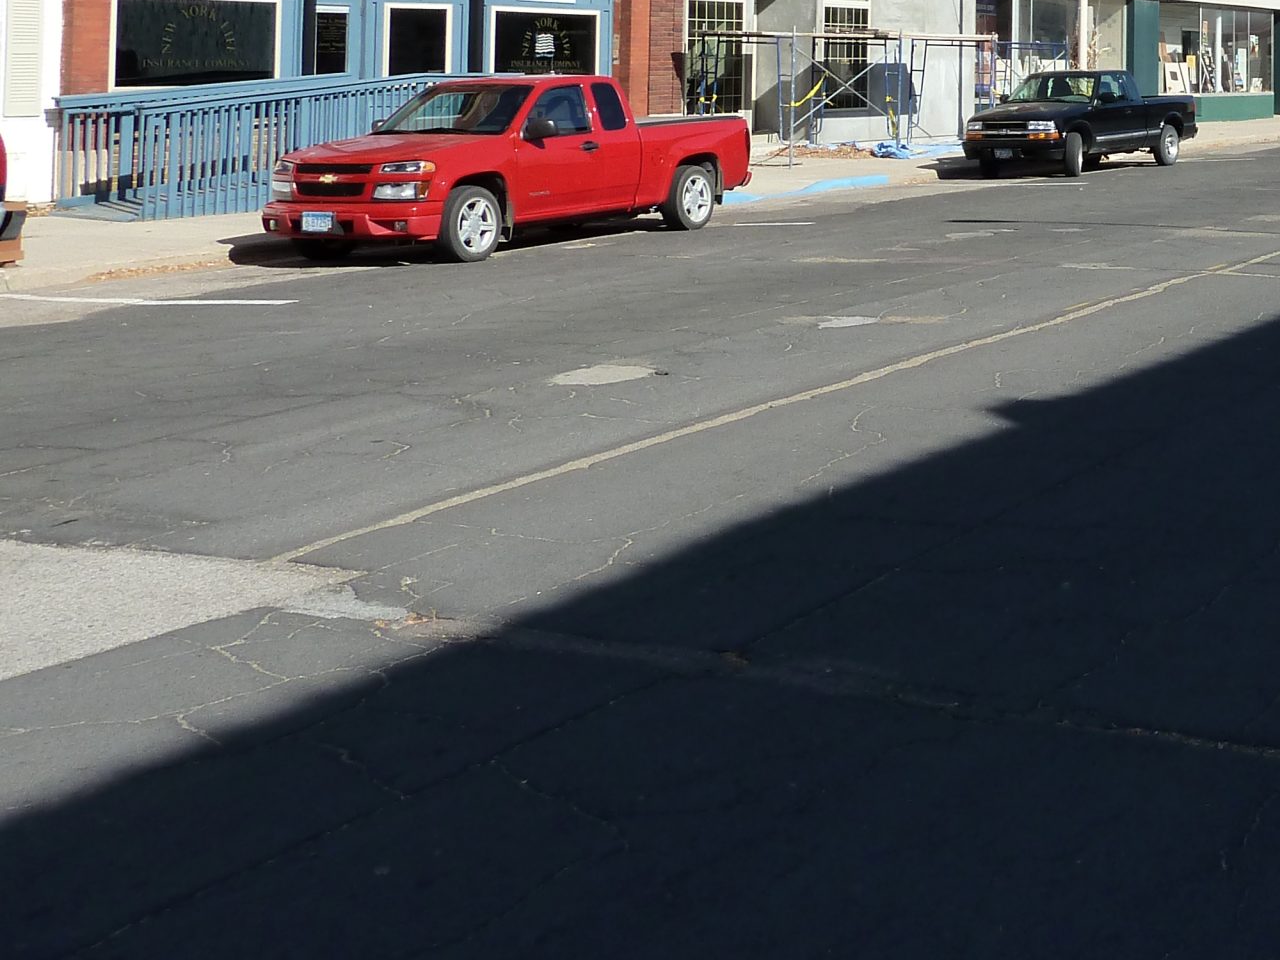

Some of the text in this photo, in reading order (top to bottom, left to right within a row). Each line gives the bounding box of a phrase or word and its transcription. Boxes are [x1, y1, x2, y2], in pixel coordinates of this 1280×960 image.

[180, 4, 218, 22] YORK
[534, 17, 560, 31] YORK
[142, 58, 200, 69] INSURANCE
